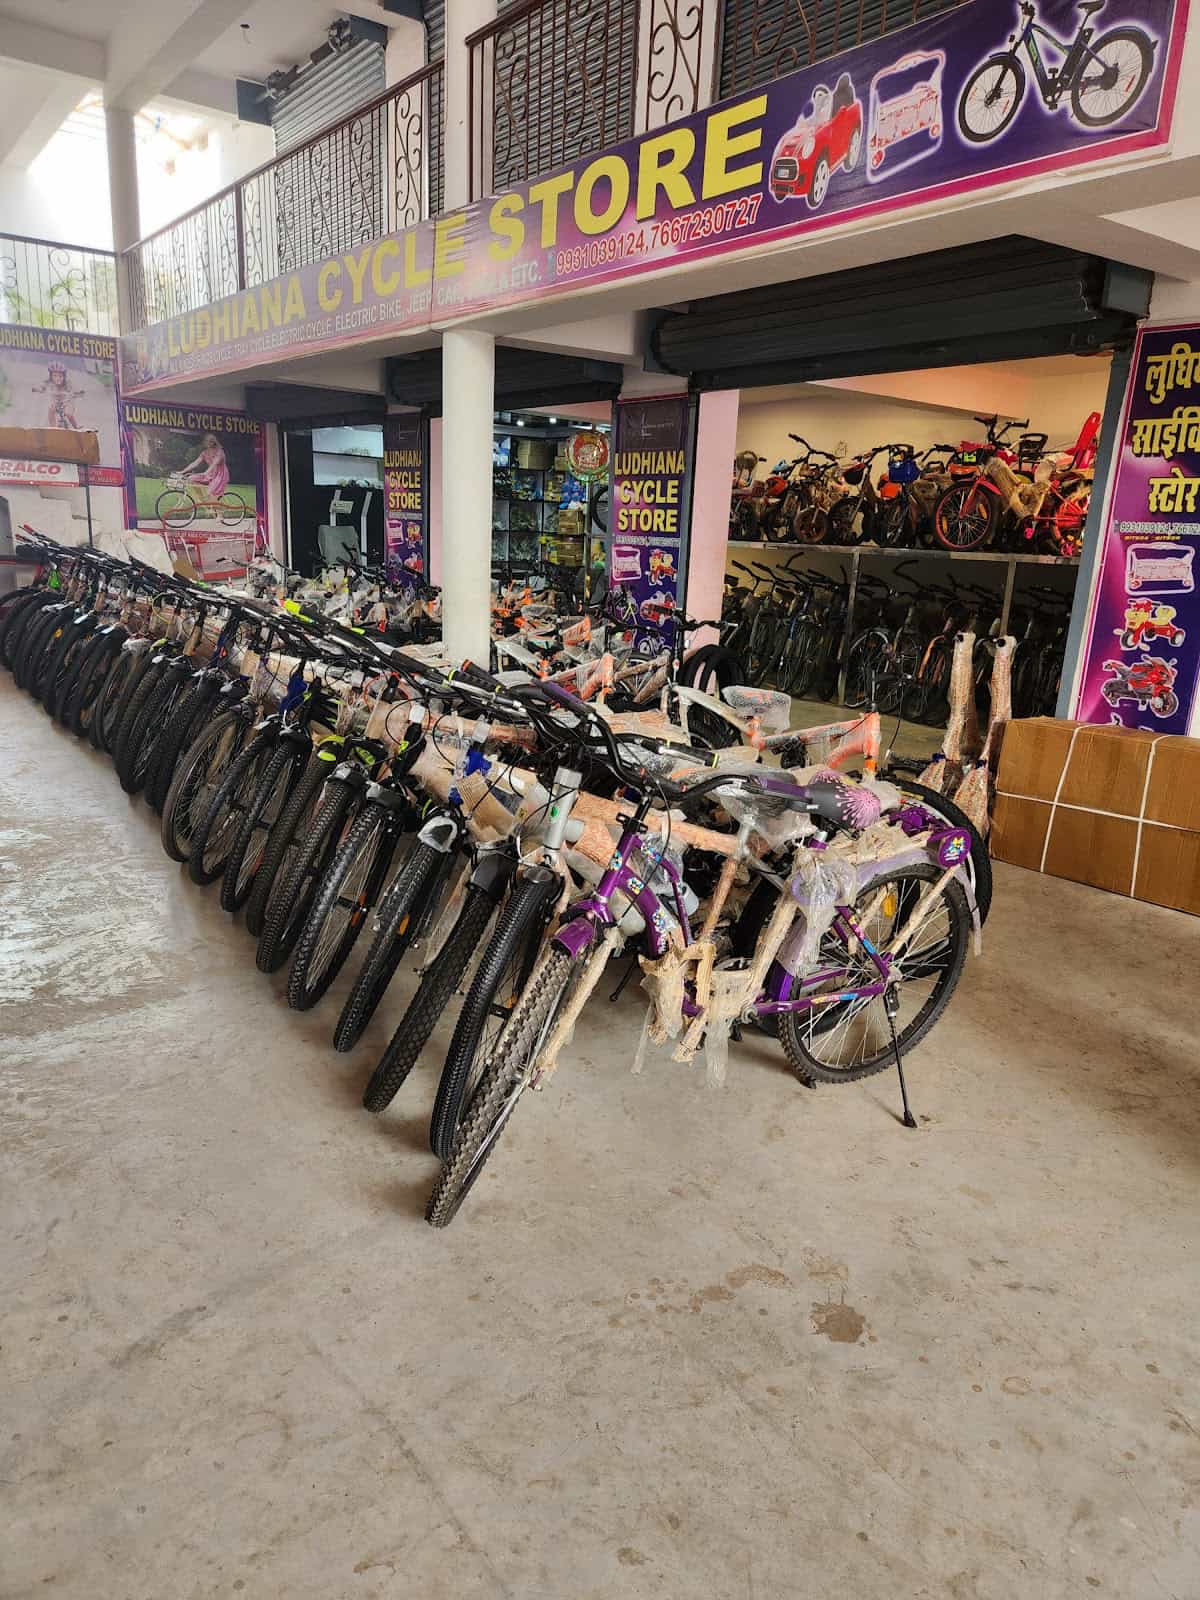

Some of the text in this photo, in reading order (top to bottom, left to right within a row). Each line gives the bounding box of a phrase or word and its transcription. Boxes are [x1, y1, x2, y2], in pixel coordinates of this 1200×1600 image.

[167, 94, 768, 357] LUDHIANA CYCLE STORE
[556, 192, 763, 275] 9931039124,7667230727
[335, 305, 378, 332] ELECTRIC
[47, 334, 81, 355] CYCLE
[82, 337, 115, 359] STORE
[125, 405, 261, 434] LUDHIANA CYCLE STORE
[614, 449, 686, 476] LUDHIANA
[389, 471, 421, 489] CYCLE
[619, 479, 679, 504] CYCLE
[389, 492, 421, 510] STORE
[617, 507, 678, 532] STORE
